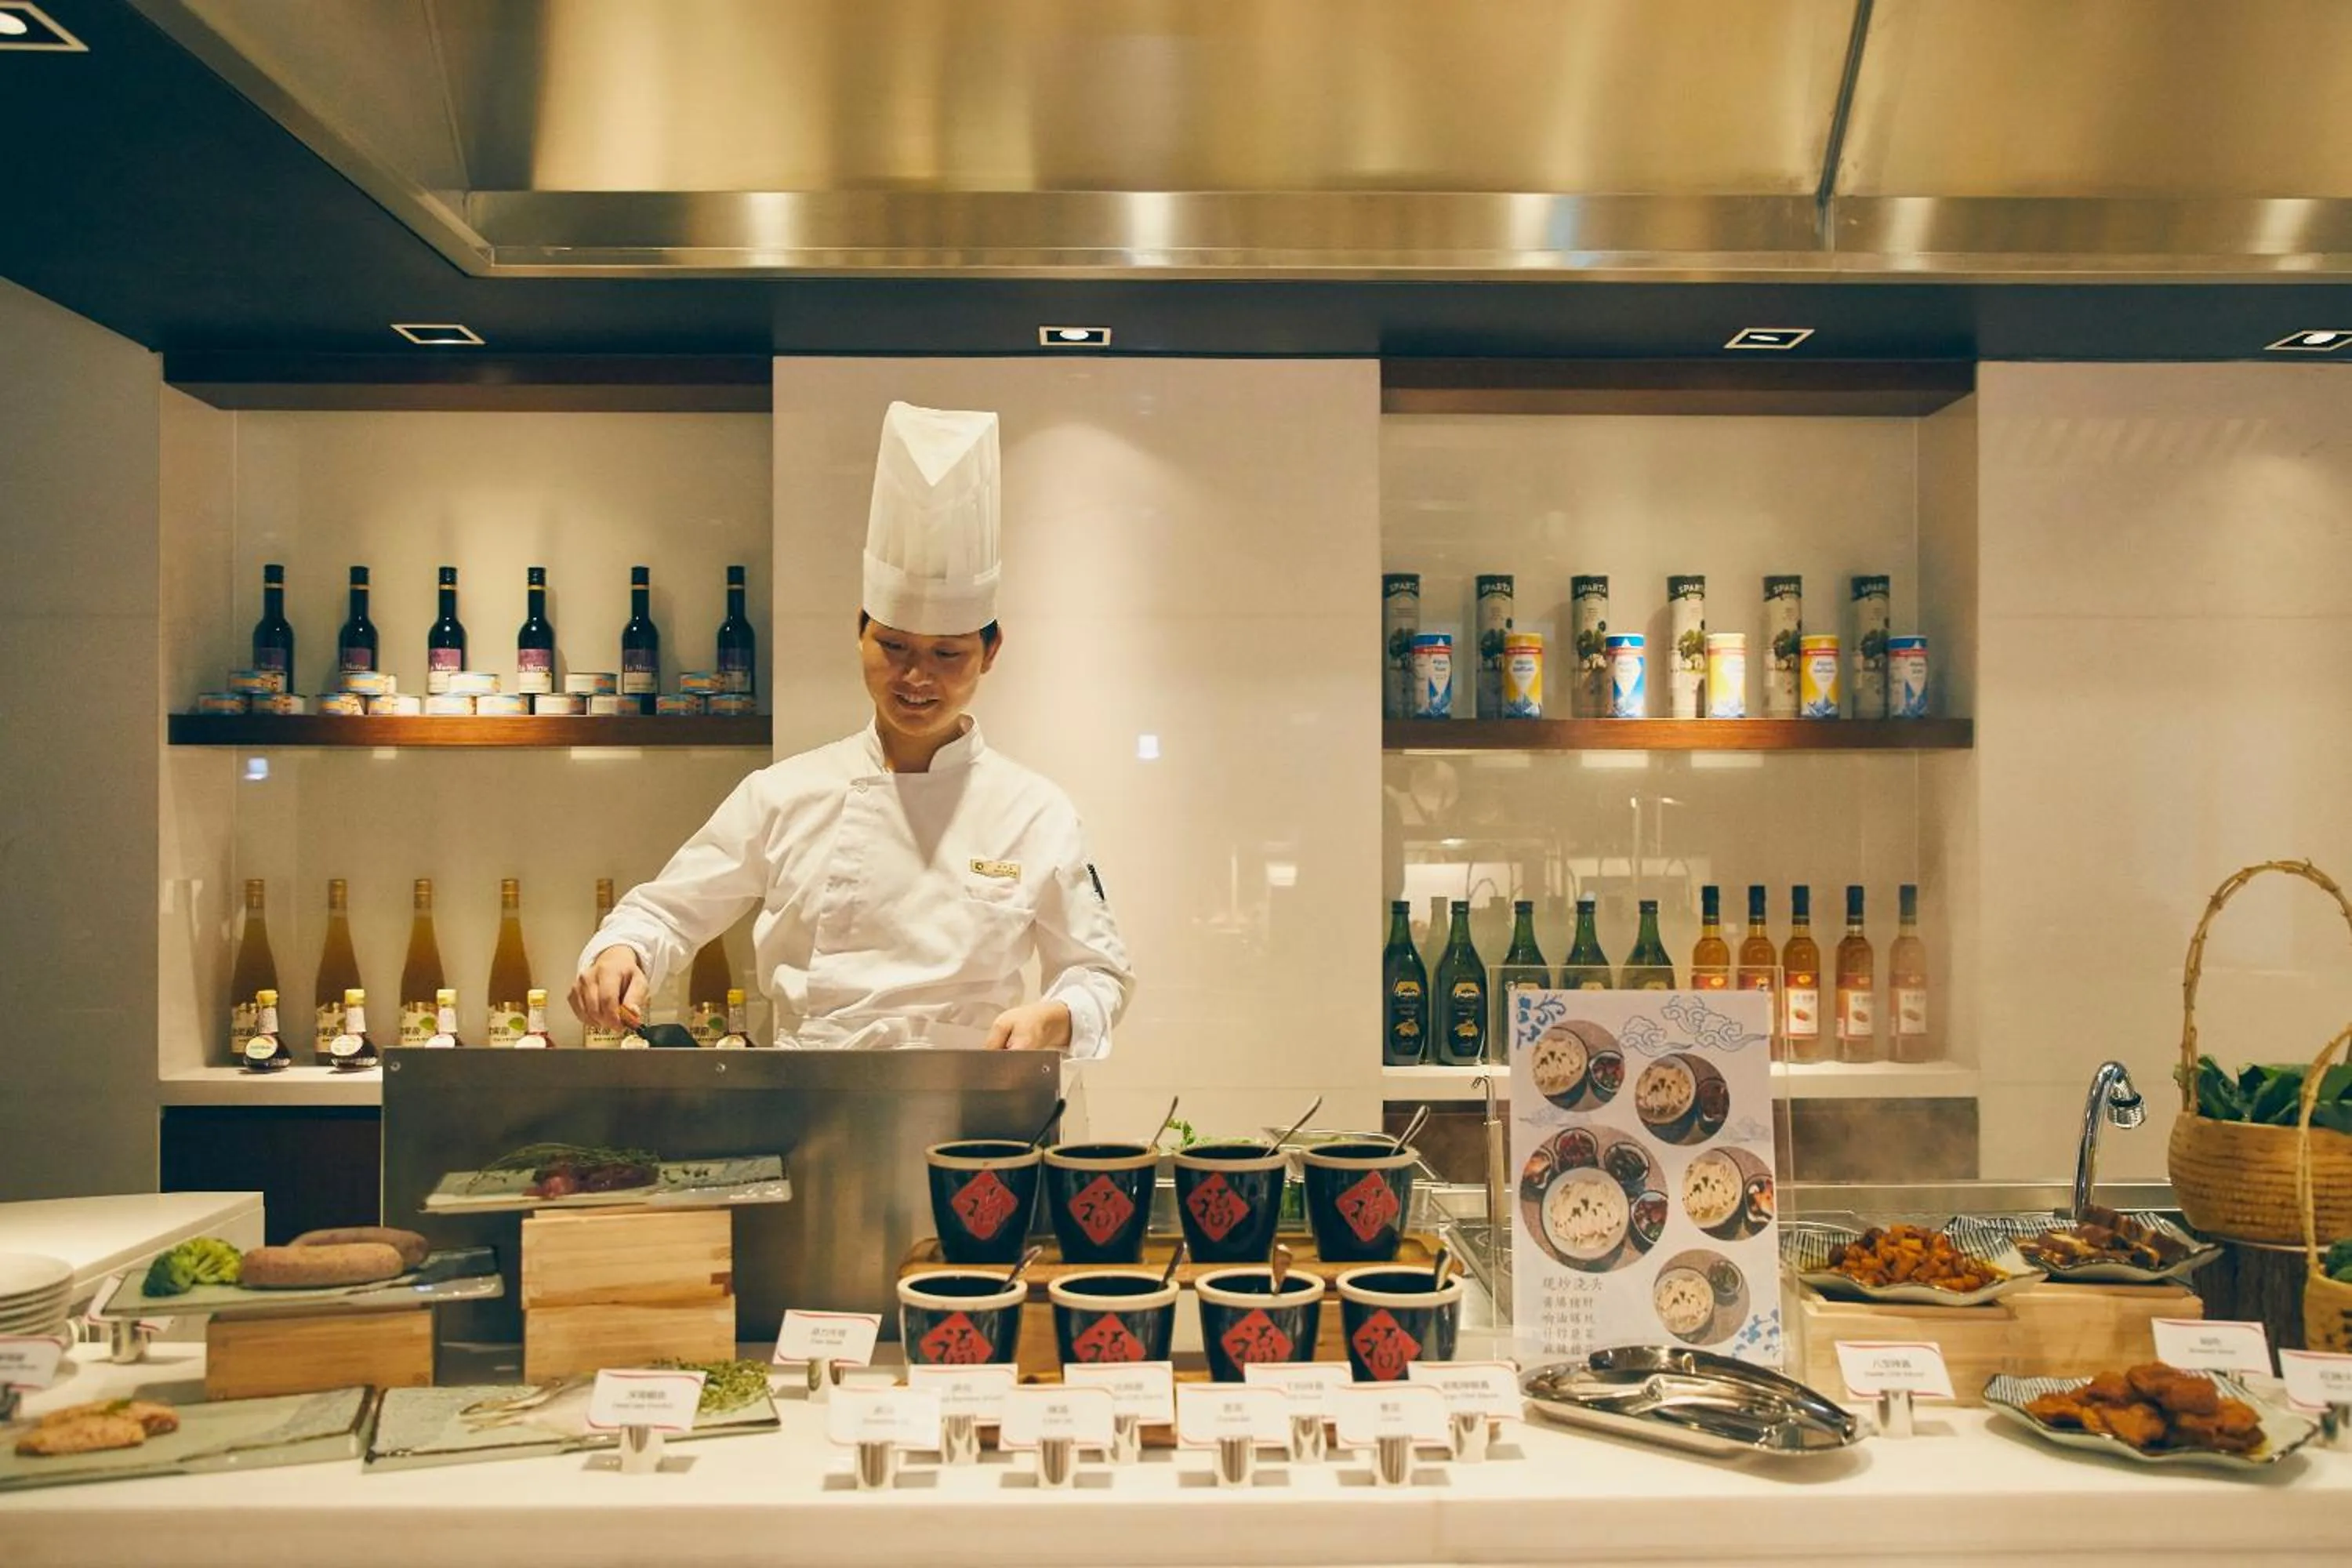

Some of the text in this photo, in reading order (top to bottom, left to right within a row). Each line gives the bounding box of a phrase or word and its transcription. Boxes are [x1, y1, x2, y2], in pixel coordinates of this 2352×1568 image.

[1196, 1187, 1235, 1228] 福
[930, 1328, 977, 1363] 福
[1083, 1330, 1128, 1362] 福
[1232, 1324, 1278, 1362] 福
[1360, 1326, 1405, 1369] 福
